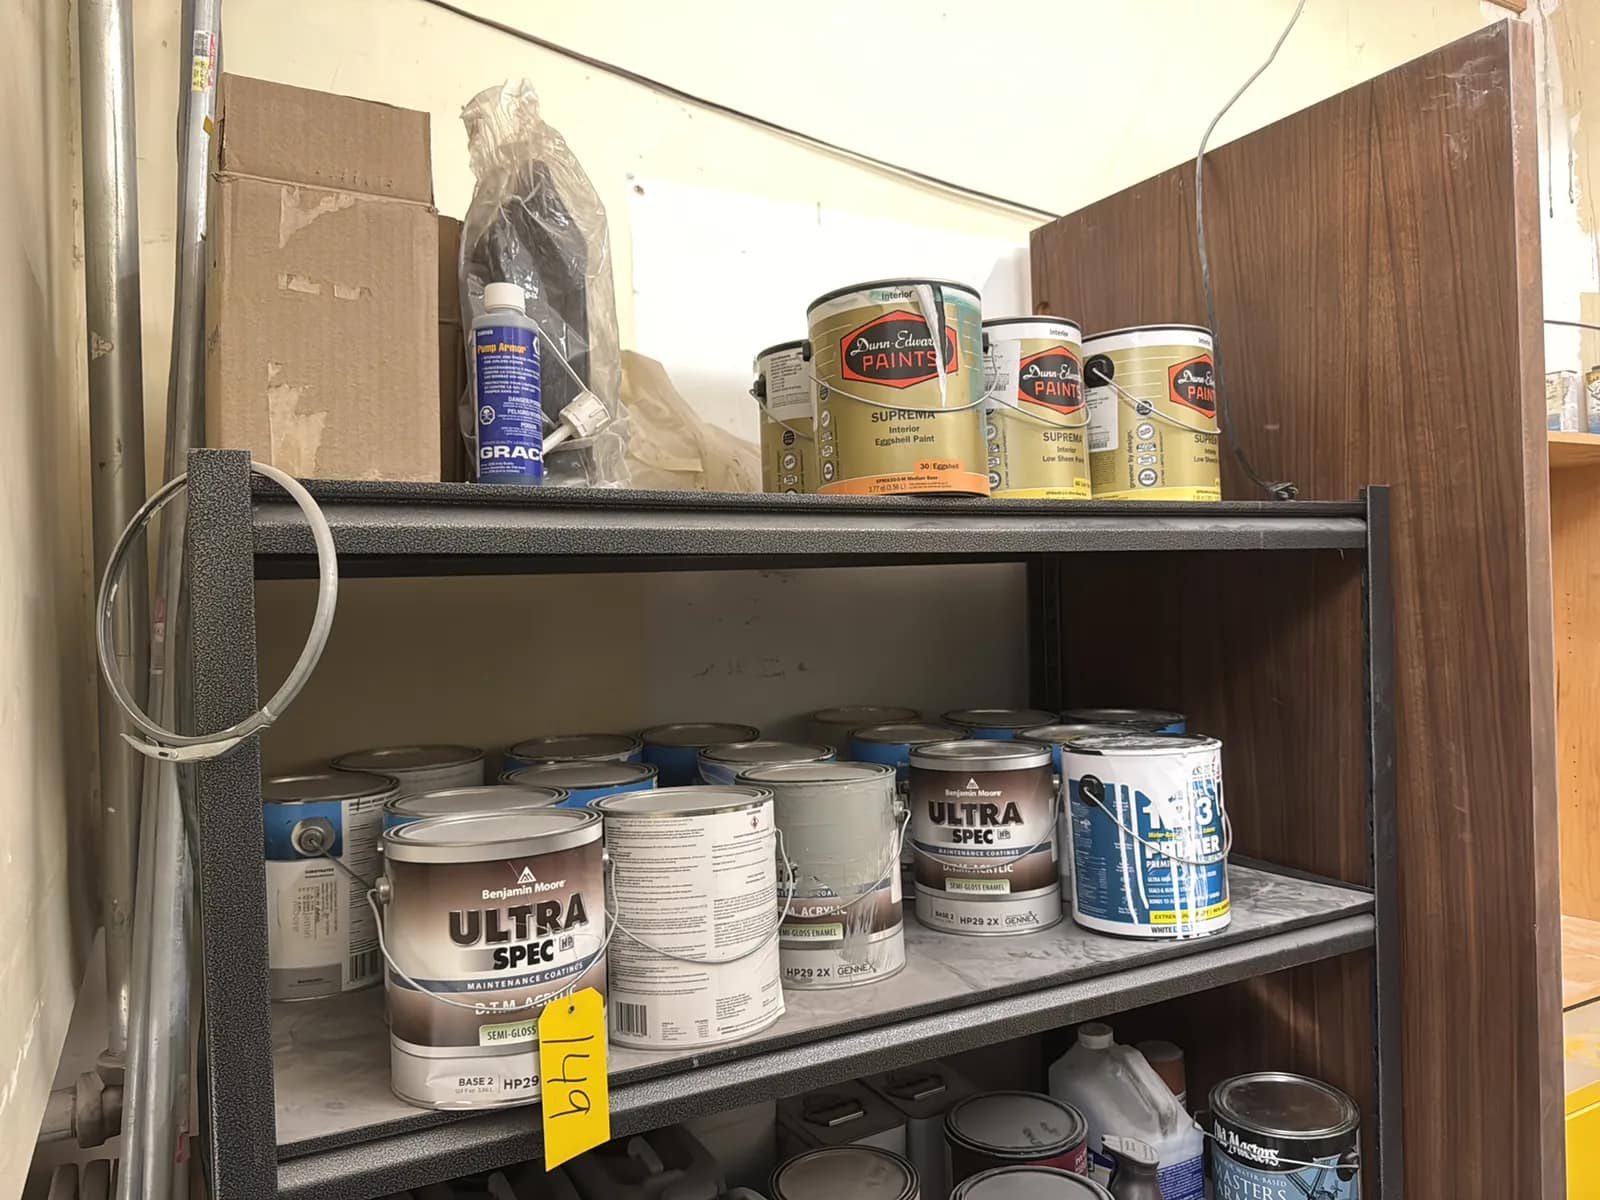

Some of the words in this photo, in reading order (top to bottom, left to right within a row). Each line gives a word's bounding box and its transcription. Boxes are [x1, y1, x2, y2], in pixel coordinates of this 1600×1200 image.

[882, 289, 914, 301] Interior
[499, 342, 527, 354] Armor
[862, 350, 938, 372] PAINTS
[1034, 381, 1083, 400] PAINTS
[871, 409, 936, 423] SUPREMA
[889, 425, 920, 434] Interior
[874, 436, 911, 447] Eggshell
[913, 434, 935, 443] Paint
[1042, 455, 1056, 463] Low
[944, 788, 977, 799] Benjamin
[978, 789, 1004, 798] Moore
[927, 801, 1025, 827] ULTRA
[952, 828, 994, 845] SPEC
[938, 848, 985, 858] MAINTENANCE
[985, 848, 1020, 858] COATINGS
[482, 885, 533, 900] Benjamin
[534, 879, 565, 894] Moore
[449, 892, 589, 947] ULTRA
[960, 916, 984, 926] HP29
[987, 917, 999, 926] 2X
[812, 927, 837, 937] ENAMEL
[493, 941, 555, 971] SPEC
[786, 967, 814, 977] HP29
[816, 967, 831, 977] 2X
[837, 959, 877, 976] GENNEX
[467, 974, 540, 990] MAINTENANCE
[544, 962, 583, 980] COATINGS
[487, 1022, 537, 1041] SEMI-GLOSS
[458, 1077, 486, 1087] BASE
[487, 1076, 494, 1086] 2
[503, 1074, 540, 1090] HP29
